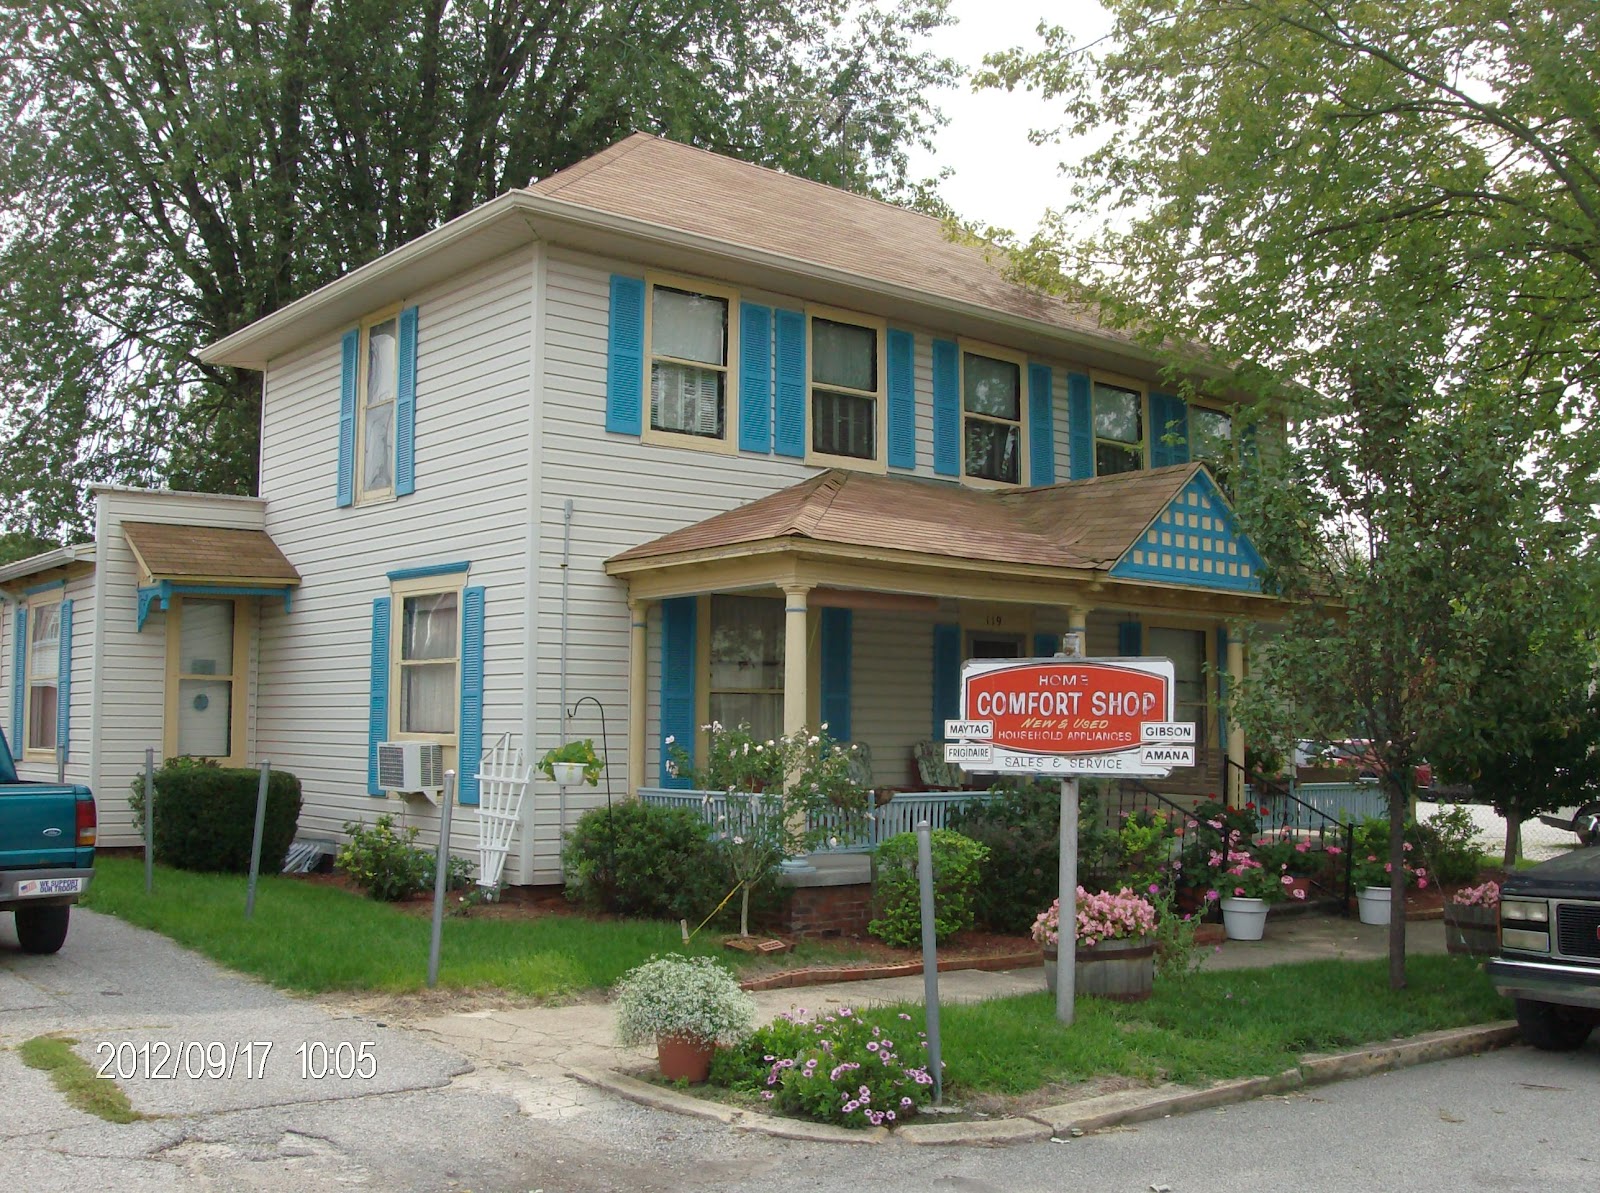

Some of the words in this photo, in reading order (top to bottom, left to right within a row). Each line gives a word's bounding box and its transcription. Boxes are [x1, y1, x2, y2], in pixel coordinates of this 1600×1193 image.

[985, 615, 1002, 627] 119
[1039, 674, 1088, 686] HOME
[977, 690, 1083, 716] COMFORT
[1091, 690, 1156, 717] SHOP
[1020, 717, 1057, 730] NEW
[1058, 718, 1069, 730] &
[1073, 718, 1109, 730] USED
[949, 724, 990, 736] MAYTAG
[998, 730, 1064, 741] HOUSEHOLD
[1067, 731, 1133, 742] APPLIANCES
[1145, 726, 1192, 737] GIBSON
[948, 748, 990, 759] FRIGIDAIRE
[1144, 750, 1190, 762] AMANA
[1004, 757, 1044, 768] SALES
[1052, 757, 1062, 768] &
[1069, 758, 1123, 770] SERVICE
[40, 885, 53, 893] OUR
[50, 879, 79, 887] SUPPORT
